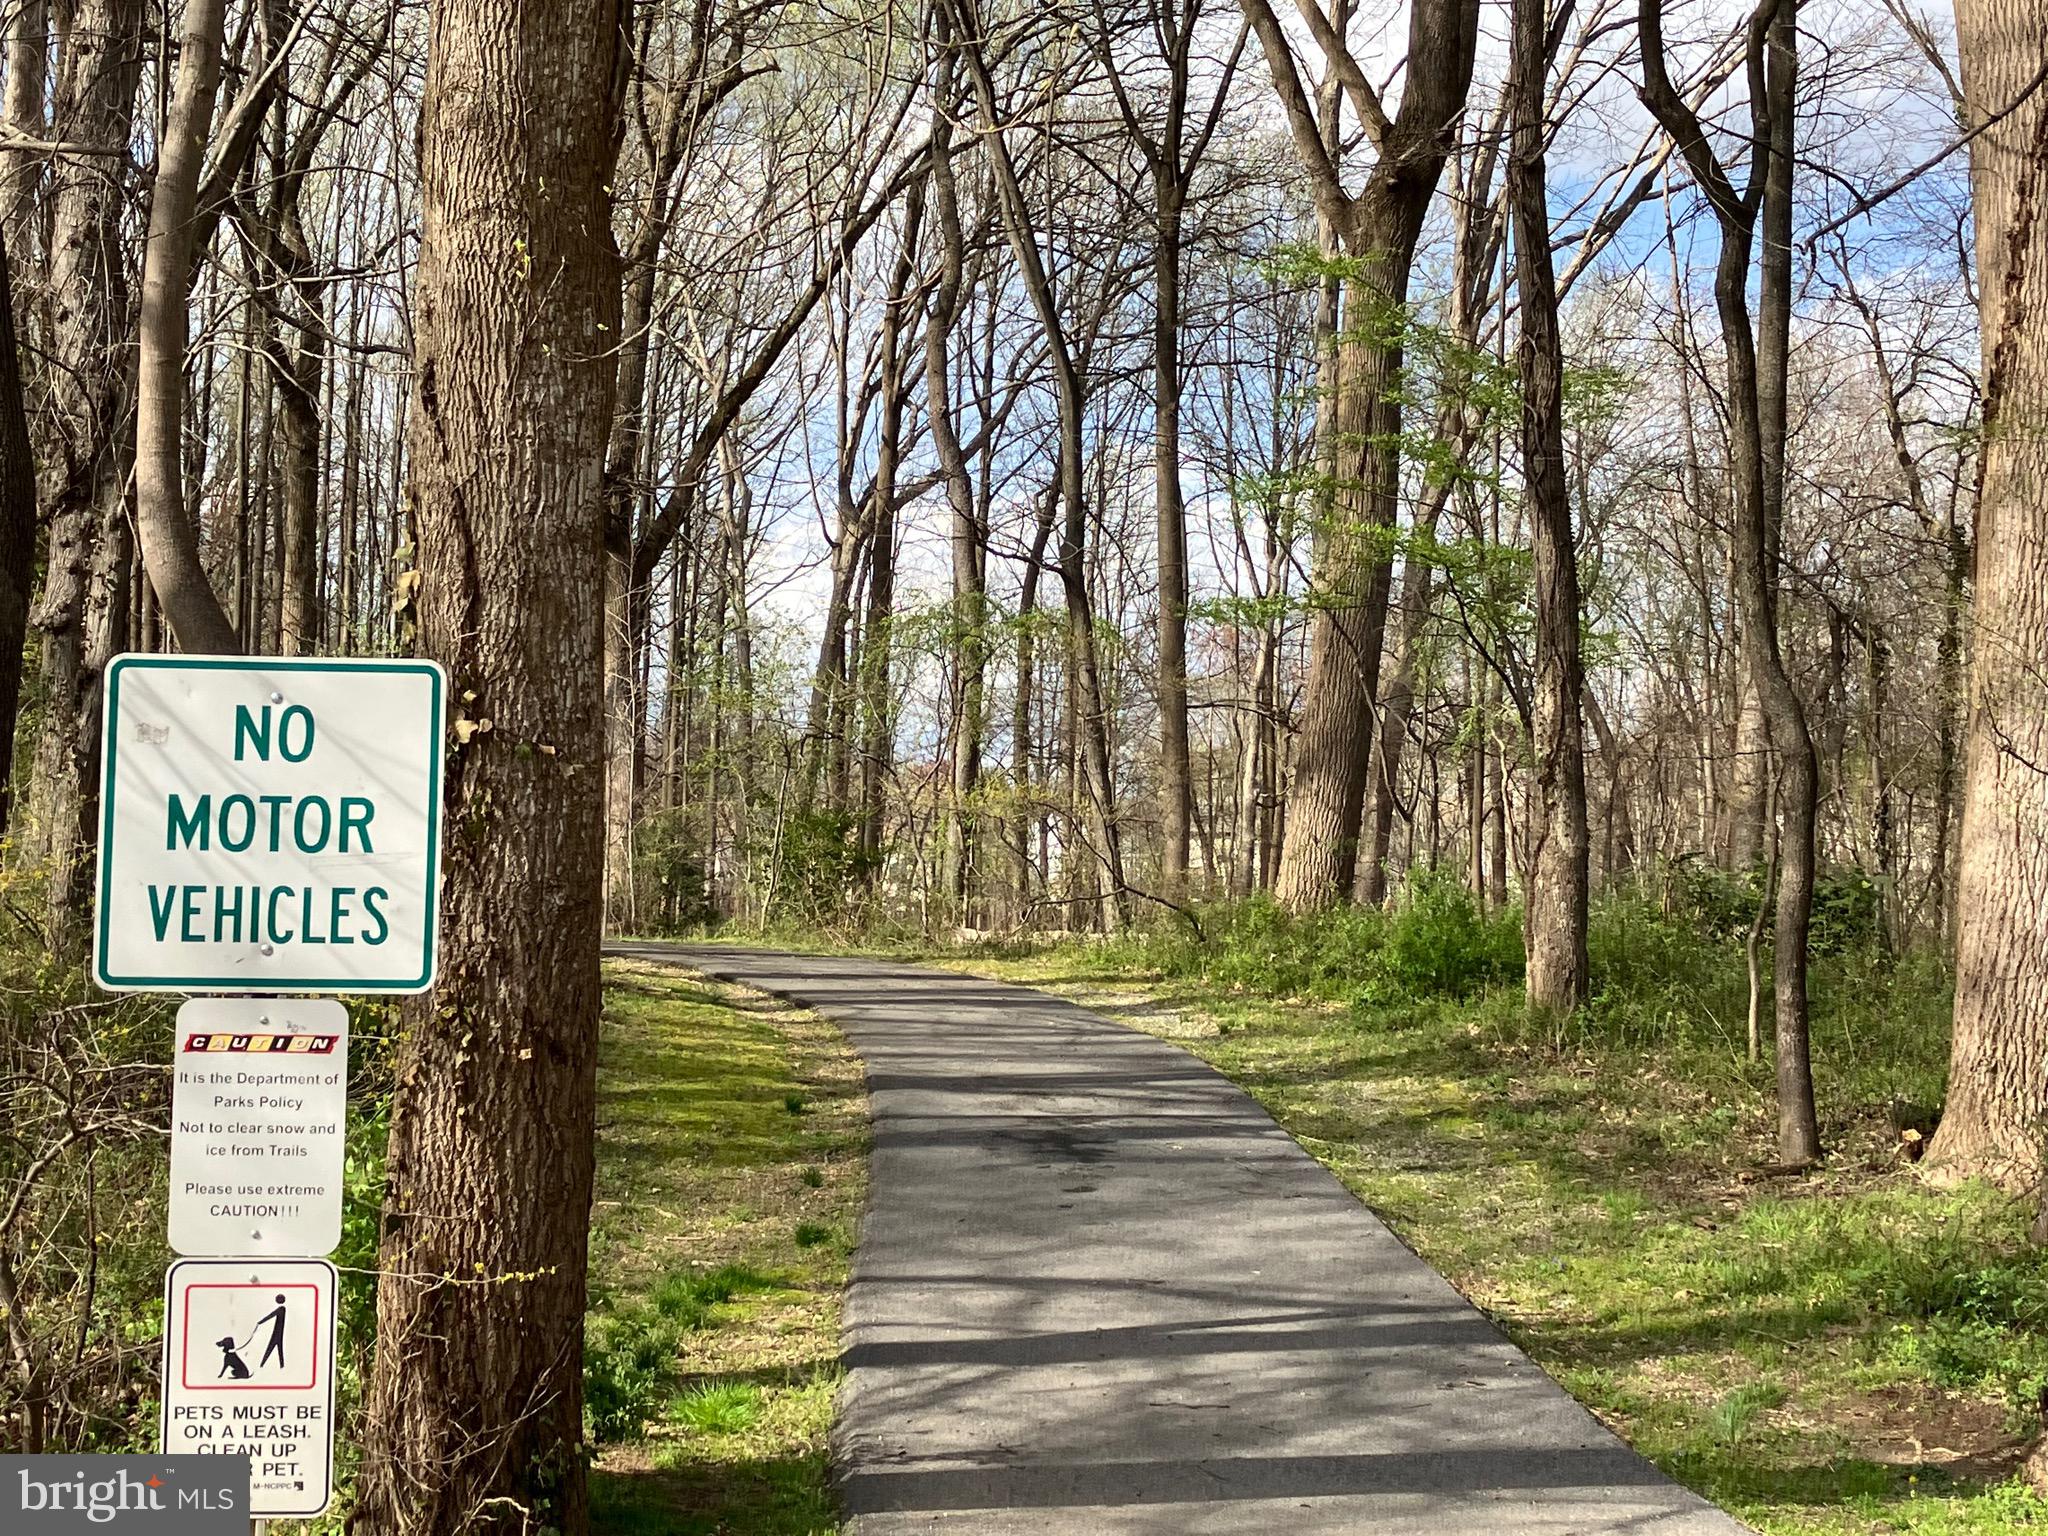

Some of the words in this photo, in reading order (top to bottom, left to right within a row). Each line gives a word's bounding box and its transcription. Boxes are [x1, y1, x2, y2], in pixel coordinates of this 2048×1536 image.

[234, 704, 315, 763] NO
[166, 794, 375, 854] MOTOR
[147, 885, 389, 945] VEHICLES
[192, 1037, 329, 1050] CAUTION
[179, 1072, 188, 1084] It
[193, 1072, 205, 1084] is
[210, 1072, 232, 1085] the
[237, 1072, 320, 1087] Department
[324, 1073, 339, 1086] of
[214, 1095, 254, 1108] Parks
[259, 1096, 303, 1111] Policy
[180, 1122, 204, 1133] Not
[209, 1123, 223, 1134] to
[227, 1121, 262, 1134] clear
[267, 1124, 305, 1135] snow
[309, 1122, 336, 1135] and
[206, 1143, 226, 1156] ice
[231, 1143, 264, 1156] from
[269, 1144, 308, 1157] Trails
[185, 1182, 233, 1195] Please
[238, 1185, 263, 1195] use
[267, 1184, 325, 1196] extreme
[210, 1204, 300, 1218] CAUTION!!!
[174, 1406, 223, 1420] PETS
[233, 1406, 288, 1420] MUST
[296, 1406, 322, 1420] BE
[184, 1425, 212, 1438] ON
[222, 1425, 234, 1438] A
[243, 1425, 311, 1438] LEASH.
[271, 1444, 297, 1457] UP
[263, 1463, 303, 1476] PET.
